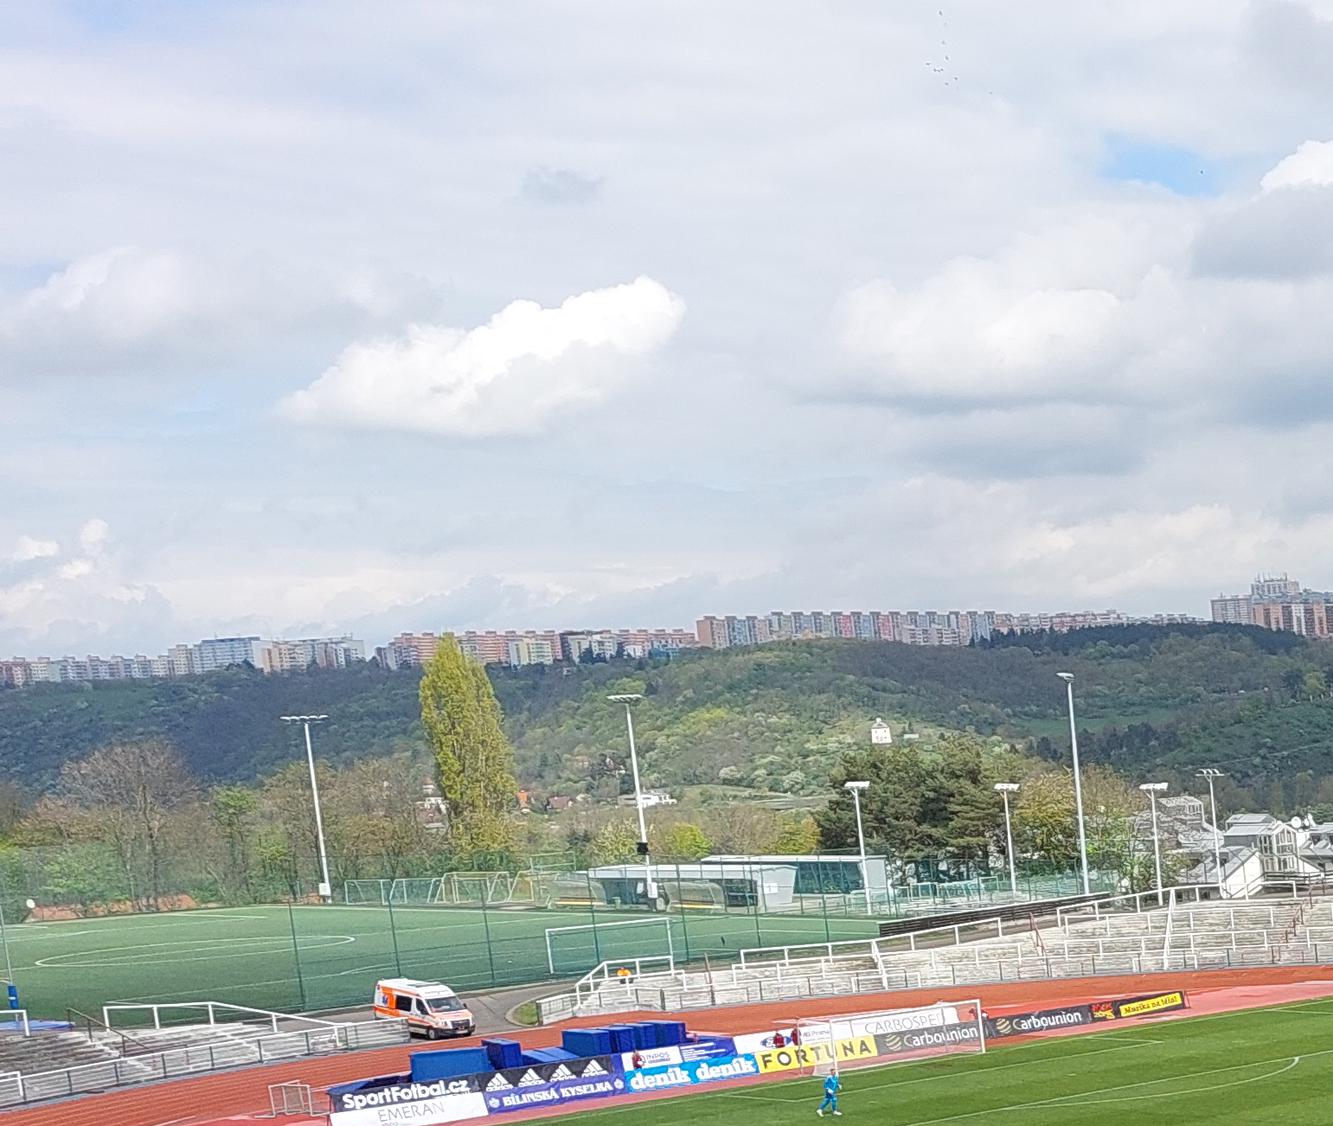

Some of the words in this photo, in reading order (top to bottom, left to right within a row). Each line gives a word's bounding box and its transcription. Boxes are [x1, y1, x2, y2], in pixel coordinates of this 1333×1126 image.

[1012, 1010, 1082, 1030] Carbounion
[903, 1026, 978, 1047] Carbounion
[761, 1039, 871, 1069] FORTUNA
[342, 1079, 470, 1109] SportFotbal.cz
